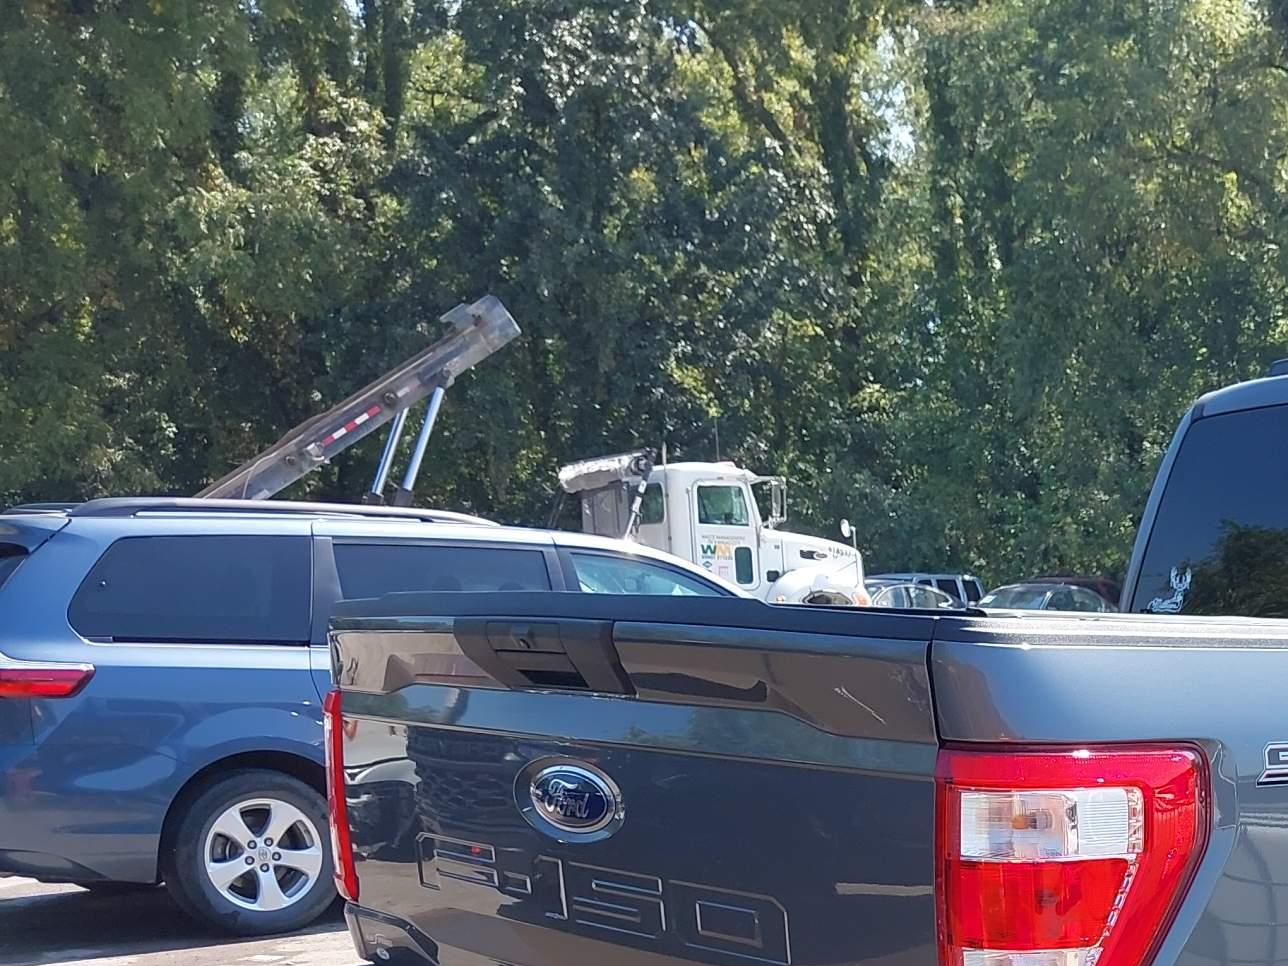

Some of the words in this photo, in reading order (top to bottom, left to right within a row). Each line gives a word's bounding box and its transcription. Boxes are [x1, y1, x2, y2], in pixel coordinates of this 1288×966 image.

[701, 544, 732, 557] WM
[544, 777, 590, 819] Ford
[415, 830, 792, 966] F-150
